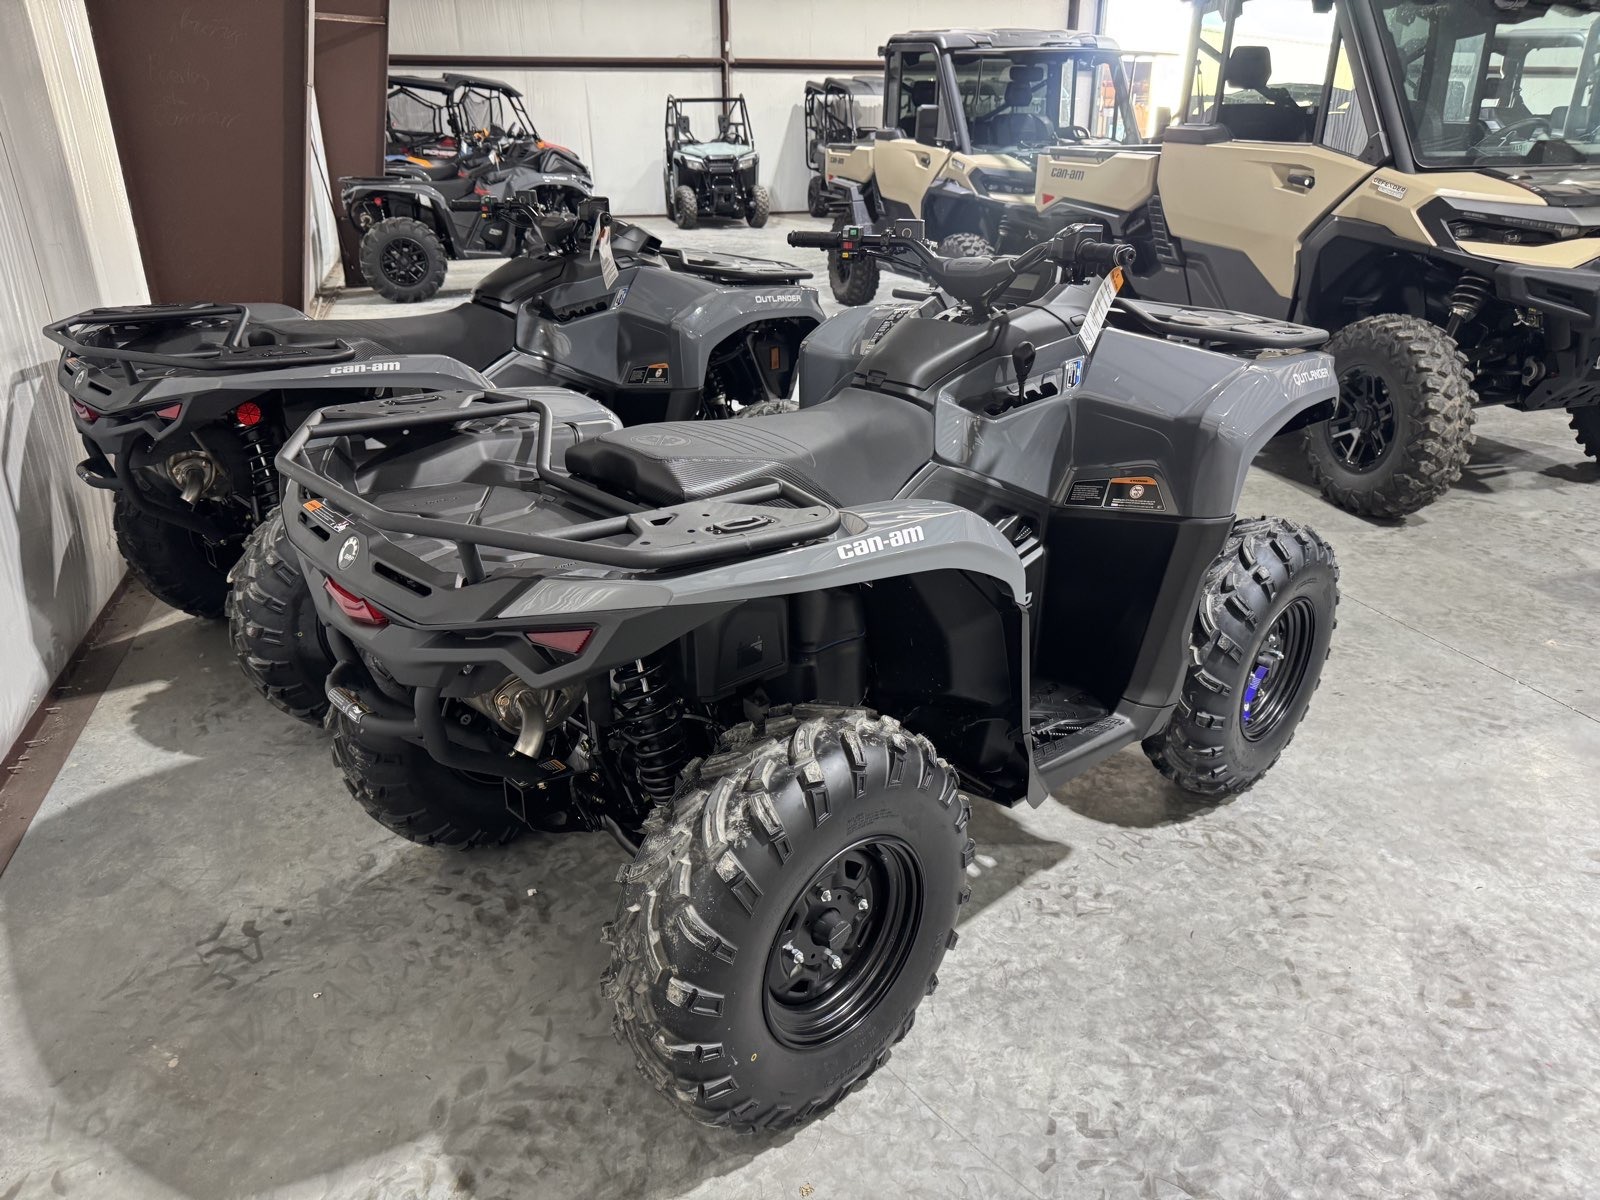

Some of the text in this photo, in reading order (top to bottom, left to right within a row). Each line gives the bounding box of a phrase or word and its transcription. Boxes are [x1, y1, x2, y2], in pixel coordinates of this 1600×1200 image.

[1051, 168, 1085, 180] can-am
[1373, 177, 1406, 192] DEFENDER
[755, 295, 801, 303] OUTLANDER
[330, 361, 400, 374] can-am
[1292, 367, 1329, 386] OUTLANDER
[836, 525, 925, 559] can-am
